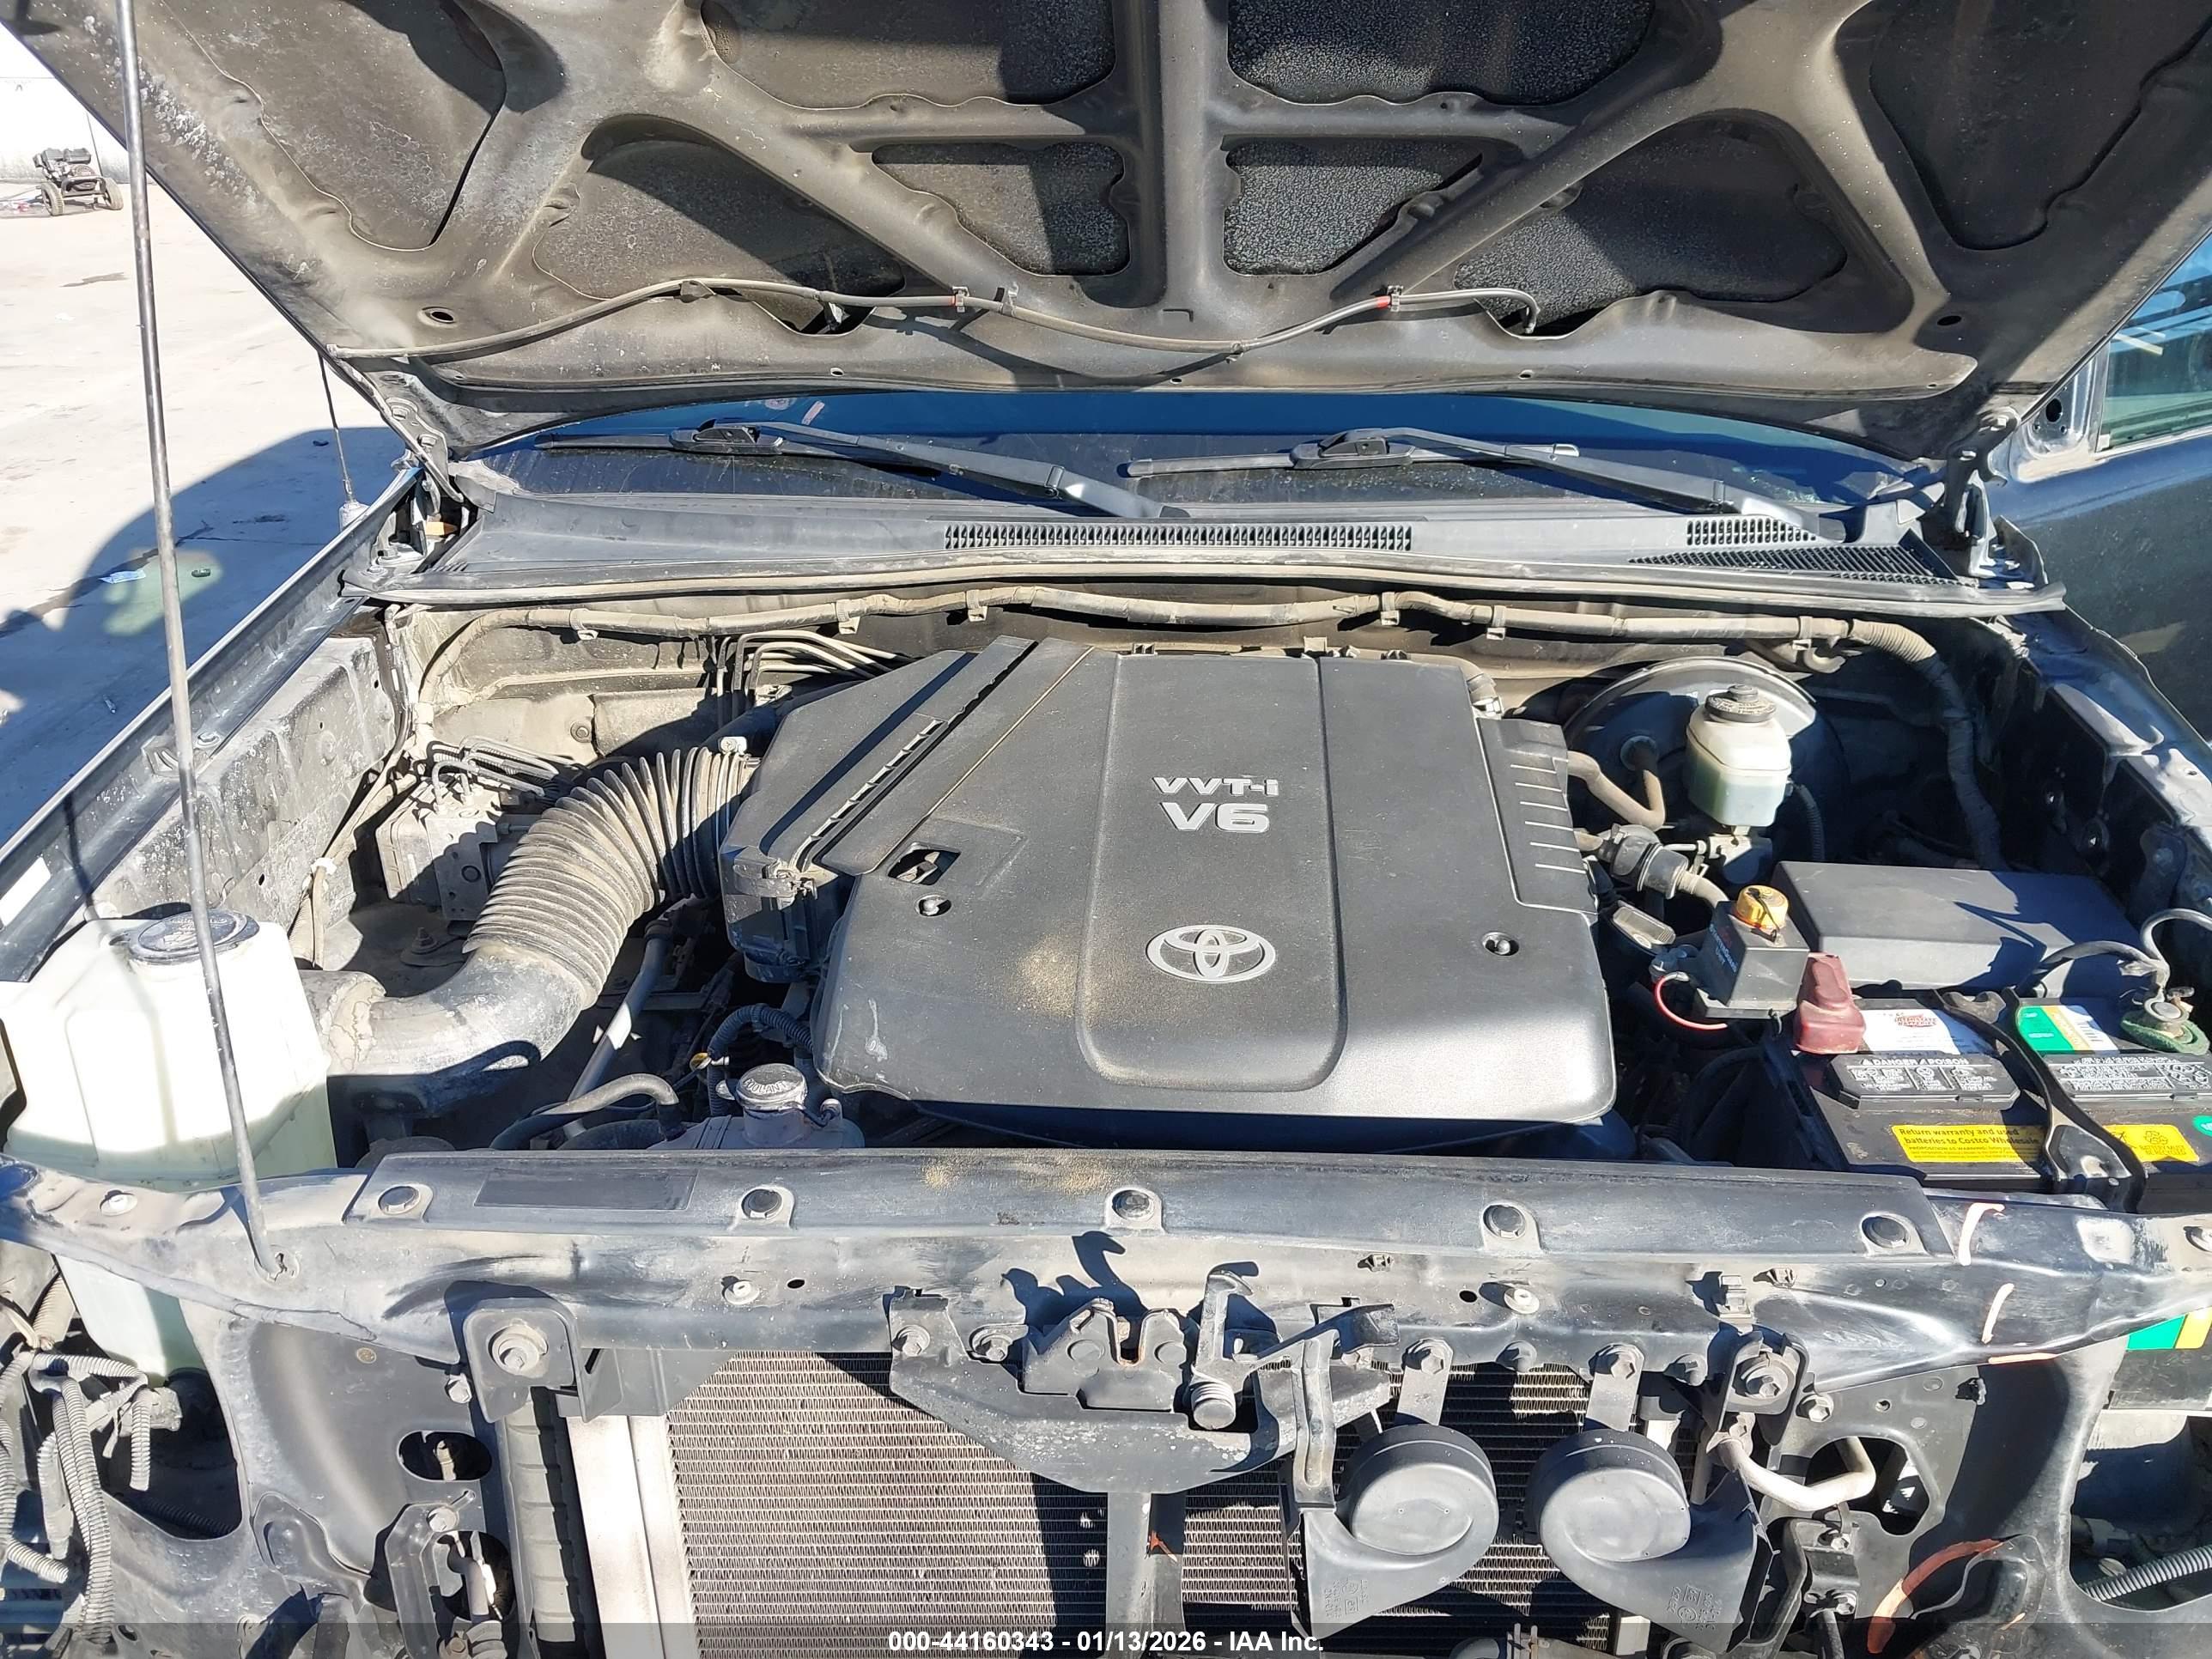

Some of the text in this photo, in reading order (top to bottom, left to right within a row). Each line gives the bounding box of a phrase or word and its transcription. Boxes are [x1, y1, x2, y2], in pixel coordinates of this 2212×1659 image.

[1152, 776, 1279, 796] VVT-i
[1159, 801, 1270, 833] V6
[744, 1079, 787, 1093] COOLANT
